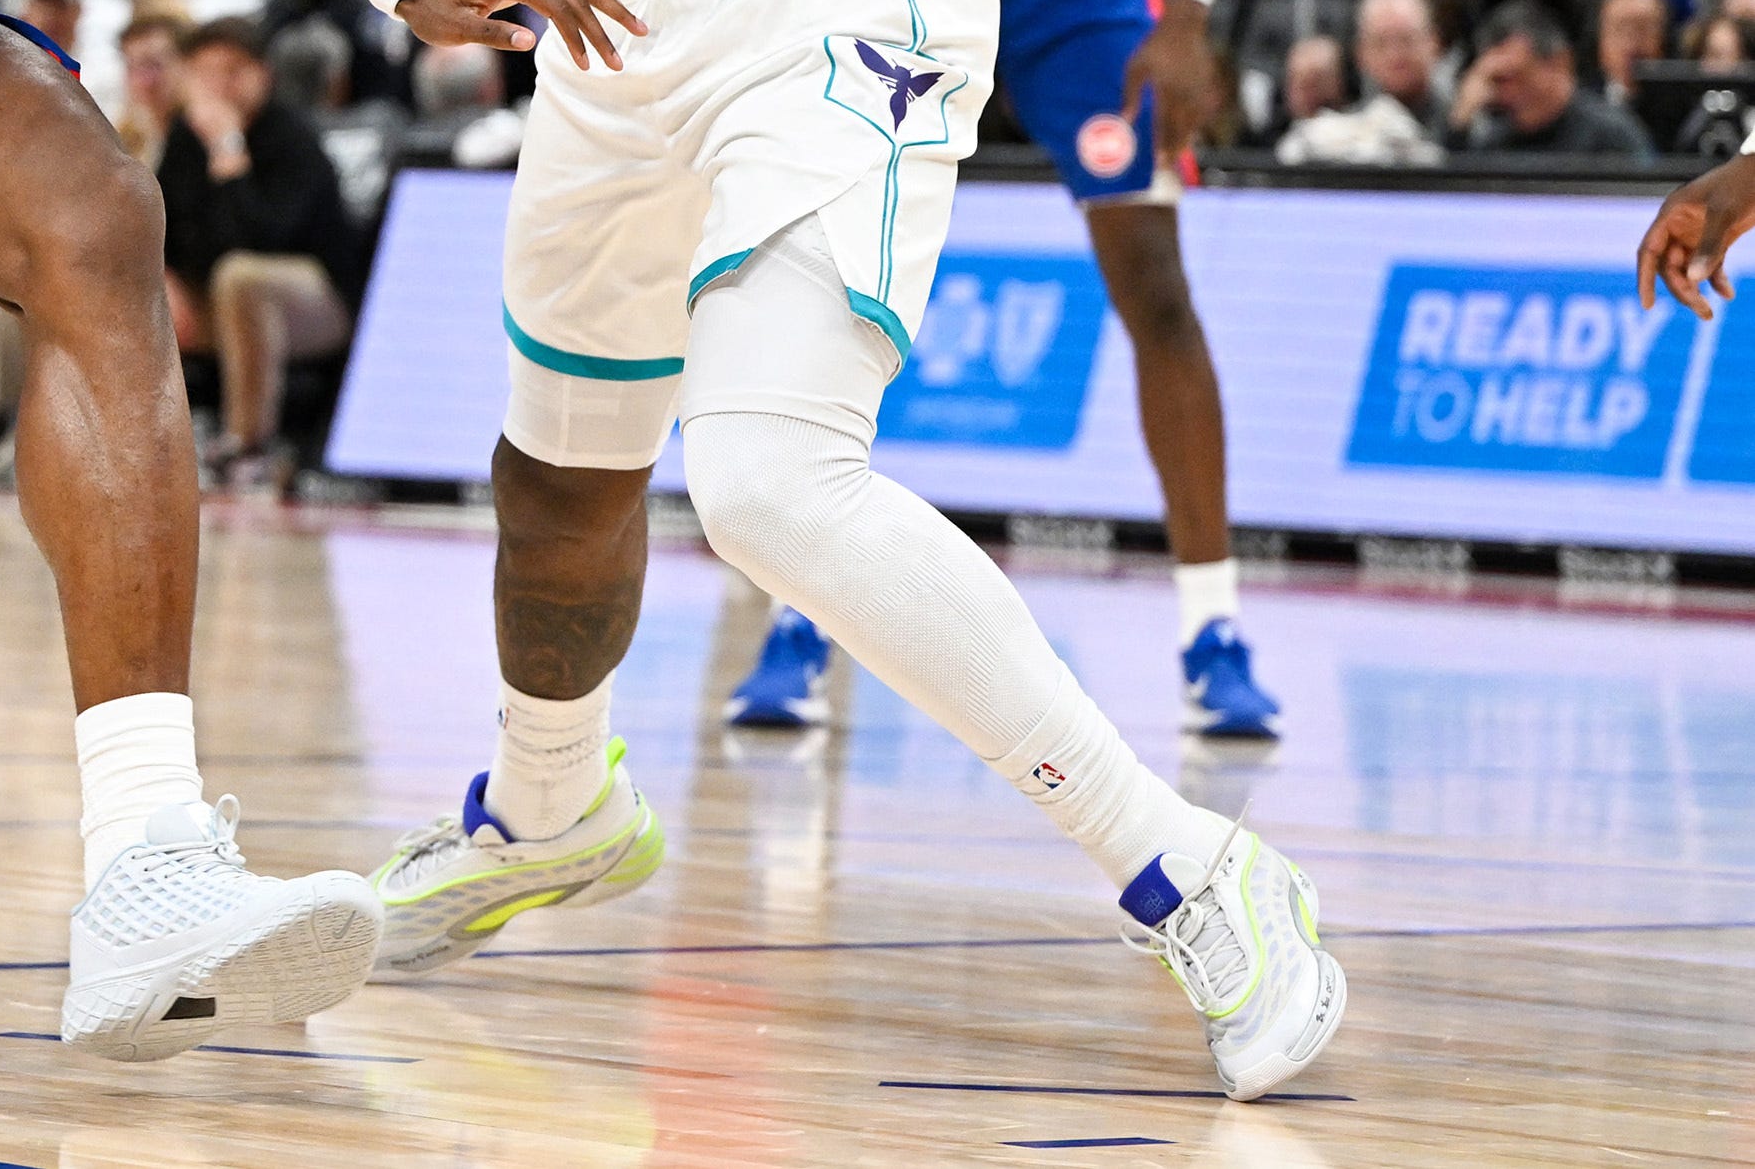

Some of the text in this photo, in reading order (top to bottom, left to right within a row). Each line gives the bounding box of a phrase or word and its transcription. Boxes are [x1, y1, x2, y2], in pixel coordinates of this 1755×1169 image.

[1398, 288, 1676, 373] READY
[1391, 365, 1651, 452] TO HELP
